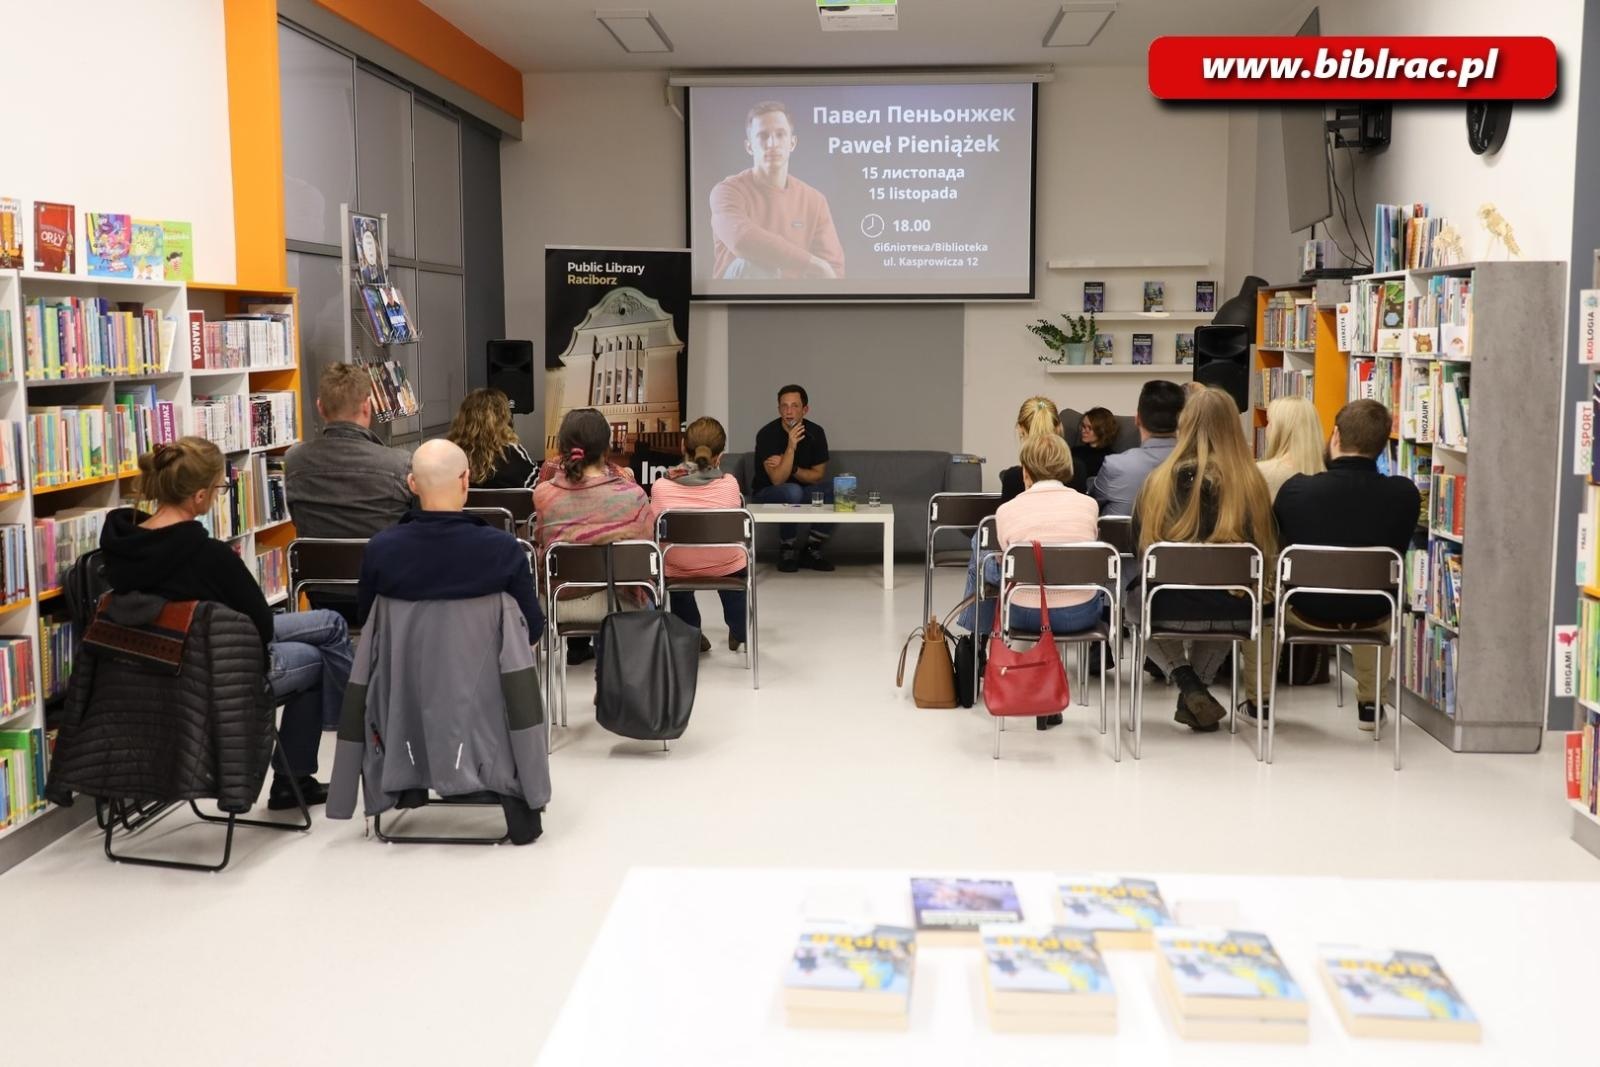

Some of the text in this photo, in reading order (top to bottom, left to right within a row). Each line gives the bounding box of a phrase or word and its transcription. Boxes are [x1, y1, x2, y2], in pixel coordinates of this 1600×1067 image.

[813, 105, 1016, 124] Павел Пеньонжек
[828, 134, 1001, 157] Paweł Pieniążek
[861, 166, 965, 182] 15 листопада
[868, 186, 958, 202] 15 listopada
[892, 219, 931, 233] 18.00
[873, 241, 988, 253] бібліотека/Biblioteka
[567, 261, 645, 276] Public Library
[883, 256, 979, 269] ul. Kasprowicza 12
[567, 274, 618, 285] Raciborz
[191, 321, 201, 361] MANGA
[1586, 311, 1595, 361] EKOLOGIA
[1421, 400, 1429, 442] DINOZAURY
[1581, 406, 1593, 448] SPORT
